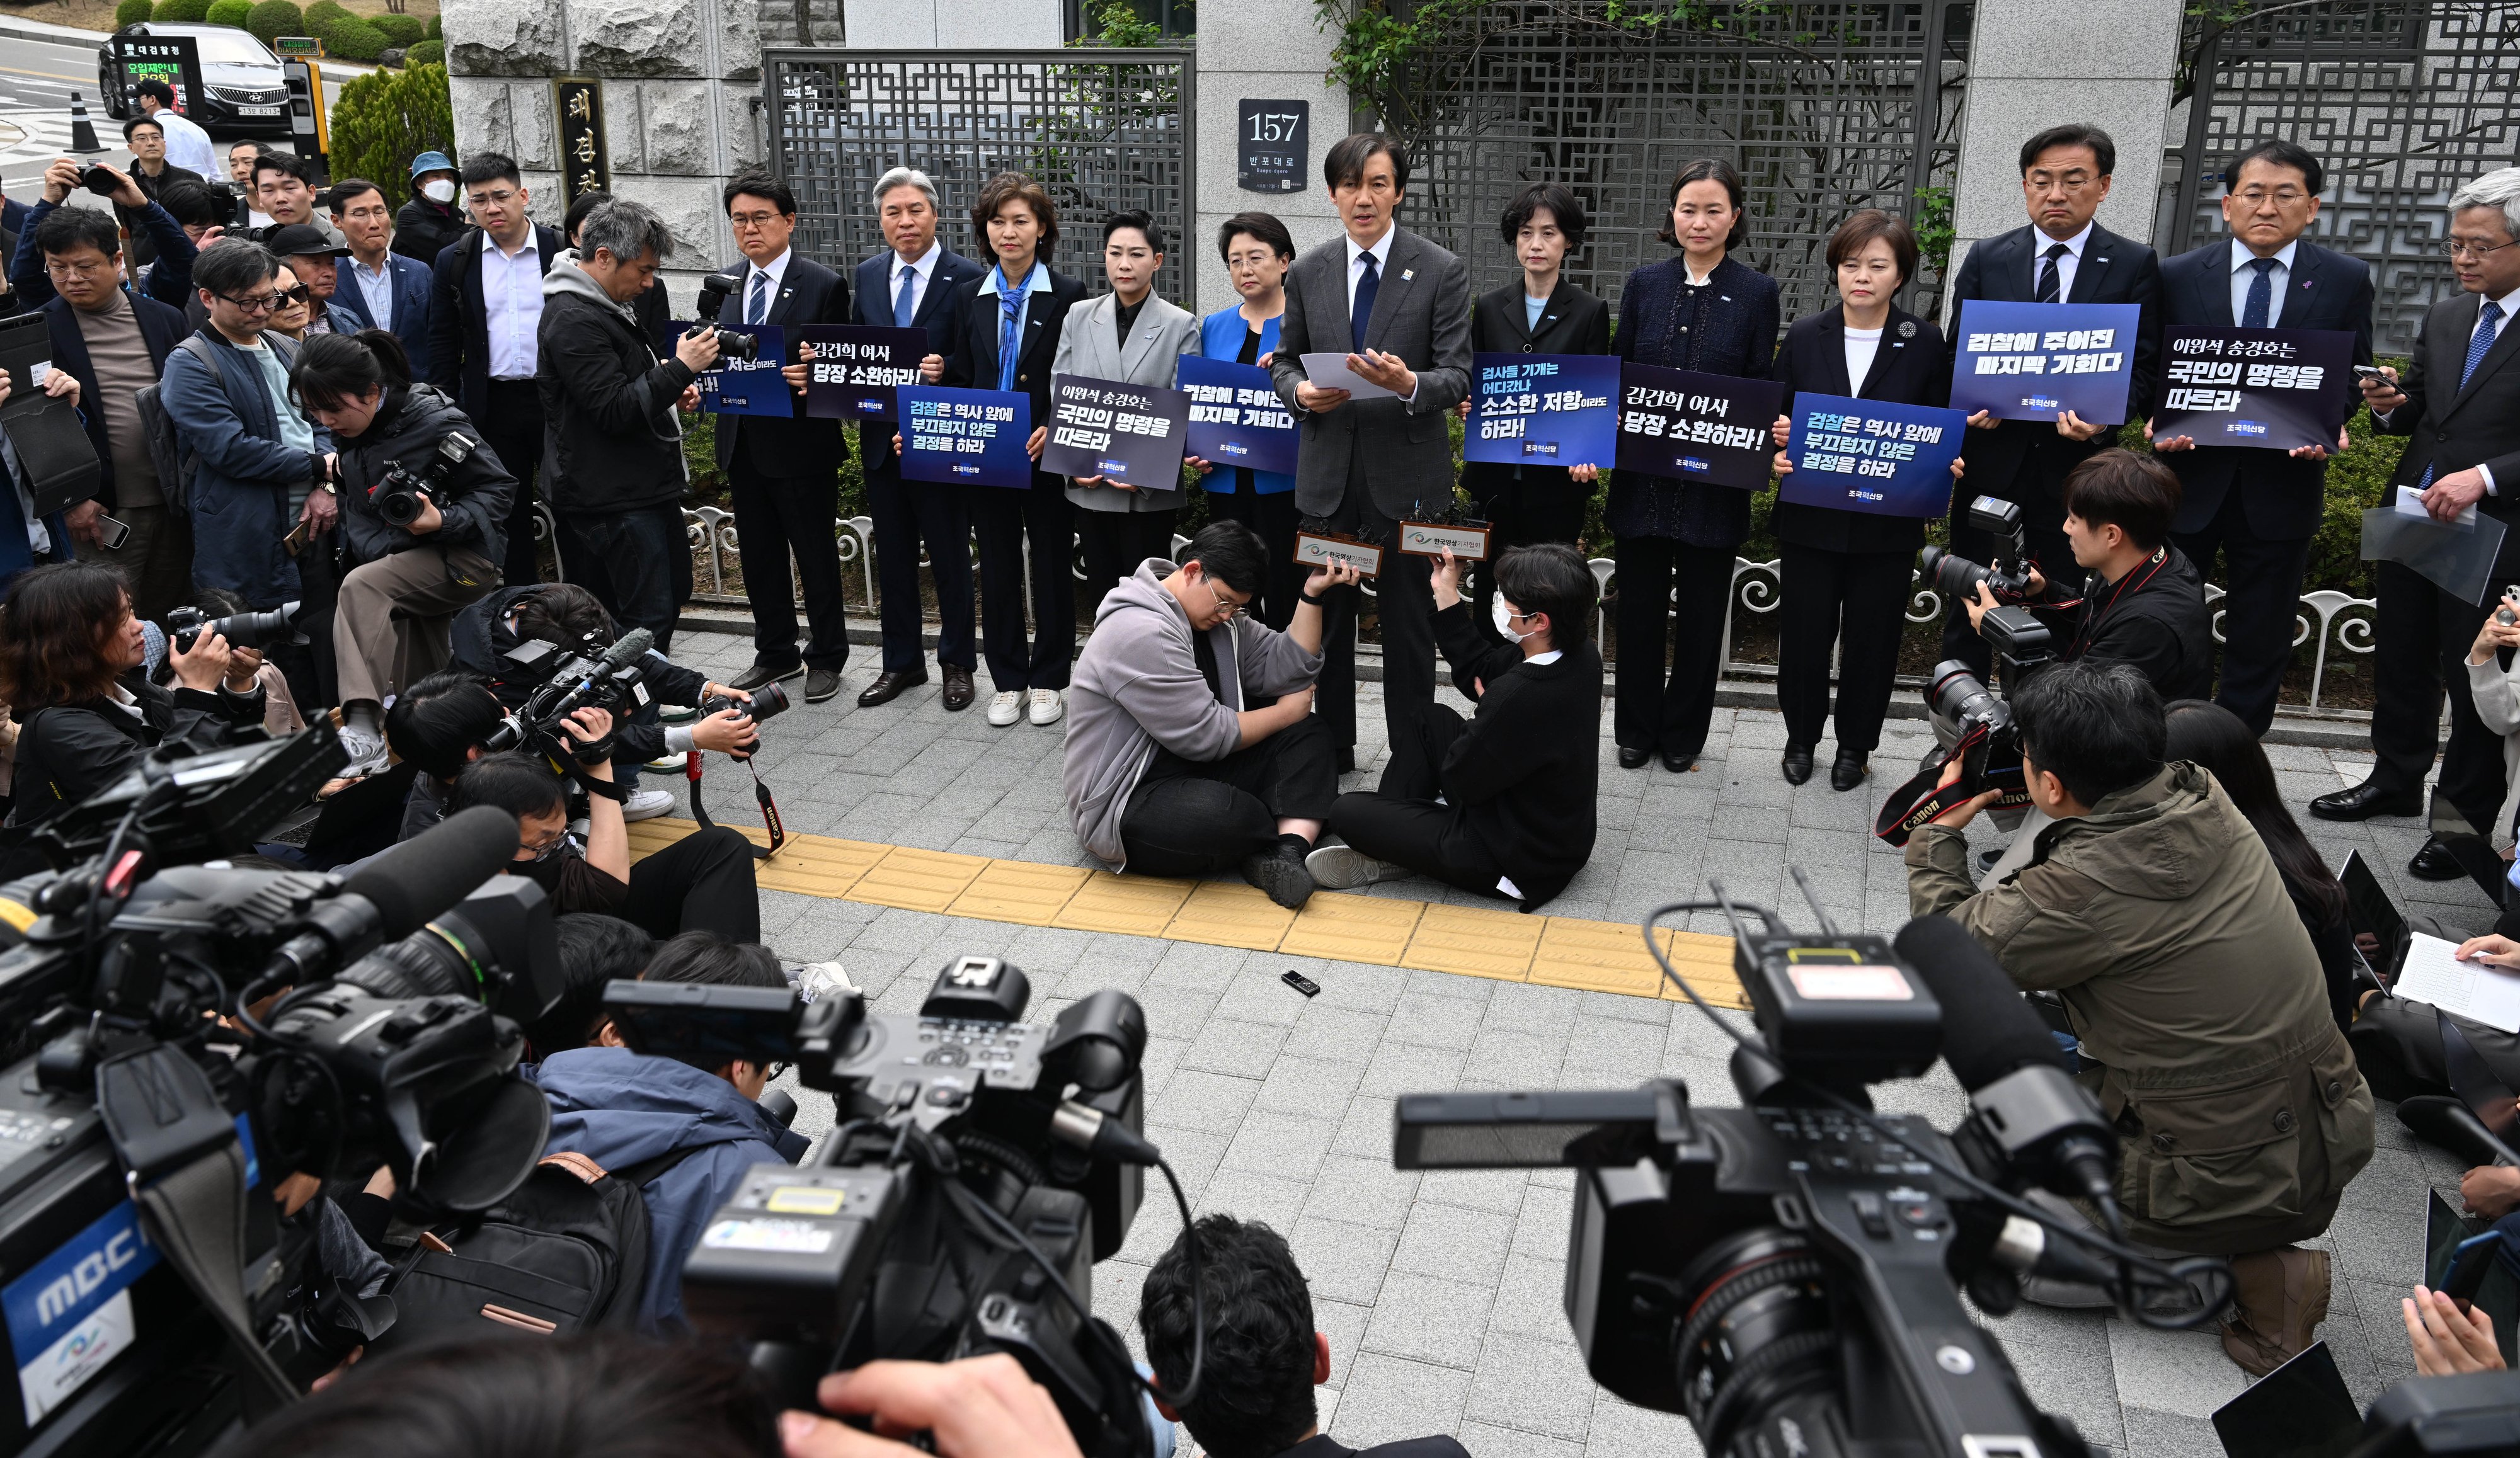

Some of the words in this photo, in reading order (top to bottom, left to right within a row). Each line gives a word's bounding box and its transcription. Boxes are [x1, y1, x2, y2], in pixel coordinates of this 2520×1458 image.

[138, 45, 180, 55] 대검찰청
[128, 63, 178, 74] 요일제안내
[1247, 113, 1300, 142] 157
[1249, 156, 1294, 166] 반포대로
[1967, 332, 2039, 352] 검찰에
[2042, 329, 2116, 351] 주어진
[2173, 338, 2224, 355] 이원석
[2227, 339, 2297, 358] 송경호는
[812, 342, 856, 360] 김건희
[861, 345, 891, 362] 여사
[1482, 365, 1518, 380] 검사들
[1521, 362, 1559, 377] 기개는
[1974, 355, 2047, 375] 마지막
[2049, 352, 2124, 374] 기회다
[813, 363, 847, 384] 당장
[850, 365, 922, 387] 소환하라!
[2168, 360, 2243, 385] 국민의
[2245, 363, 2325, 390] 명령을
[1183, 384, 1234, 404] 검찰에
[1482, 379, 1532, 395] 어디갔나
[1062, 385, 1101, 403] 이원석
[1102, 391, 1153, 411] 송경호는
[1480, 394, 1538, 417] 소소한
[1542, 390, 1608, 413] 저항이라도
[1626, 386, 1685, 411] 김건희
[1689, 395, 1729, 418] 여사
[2021, 398, 2058, 407] 조국혁신당
[2165, 388, 2242, 413] 따르라
[910, 401, 952, 418] 검찰은
[954, 404, 983, 419] 역사
[985, 406, 1014, 422] 앞에
[1056, 403, 1114, 430] 국민의
[1114, 412, 1171, 438] 명령을
[1188, 404, 1240, 424] 마지막
[1242, 409, 1295, 430] 기회다
[911, 418, 966, 436] 부끄럽지
[969, 422, 997, 438] 않은
[1480, 418, 1526, 440] 하라!
[1624, 411, 1667, 436] 당장
[1669, 418, 1766, 451] 소환하라!
[1807, 412, 1862, 434] 검찰은
[1864, 418, 1901, 439] 역사
[1903, 423, 1943, 445] 앞에
[2226, 424, 2265, 433] 조국혁신당
[912, 435, 954, 452] 결정을
[956, 438, 985, 454] 하라
[1053, 426, 1111, 452] 따르라
[1525, 444, 1557, 453] 조국혁신당
[1804, 431, 1877, 457] 부끄럽지
[1878, 441, 1916, 462] 않은
[1220, 444, 1248, 455] 조국혁신당
[953, 465, 980, 474] 조국혁신당
[1097, 462, 1126, 472] 조국혁신당
[1675, 458, 1708, 470] 조국혁신당
[1801, 452, 1856, 474] 결정을
[1858, 458, 1896, 479] 하라
[418, 482, 432, 493] Nikon
[1848, 490, 1884, 501] 조국혁신당
[1434, 538, 1480, 549] 한국영상기자협회
[1329, 551, 1374, 566] 한국영상기자협회
[599, 741, 614, 753] SONY
[49, 781, 62, 800] Nikon
[1994, 792, 2031, 804] anon
[766, 806, 781, 840] Canon
[1902, 800, 1940, 831] Canon
[36, 1226, 137, 1328] MBC
